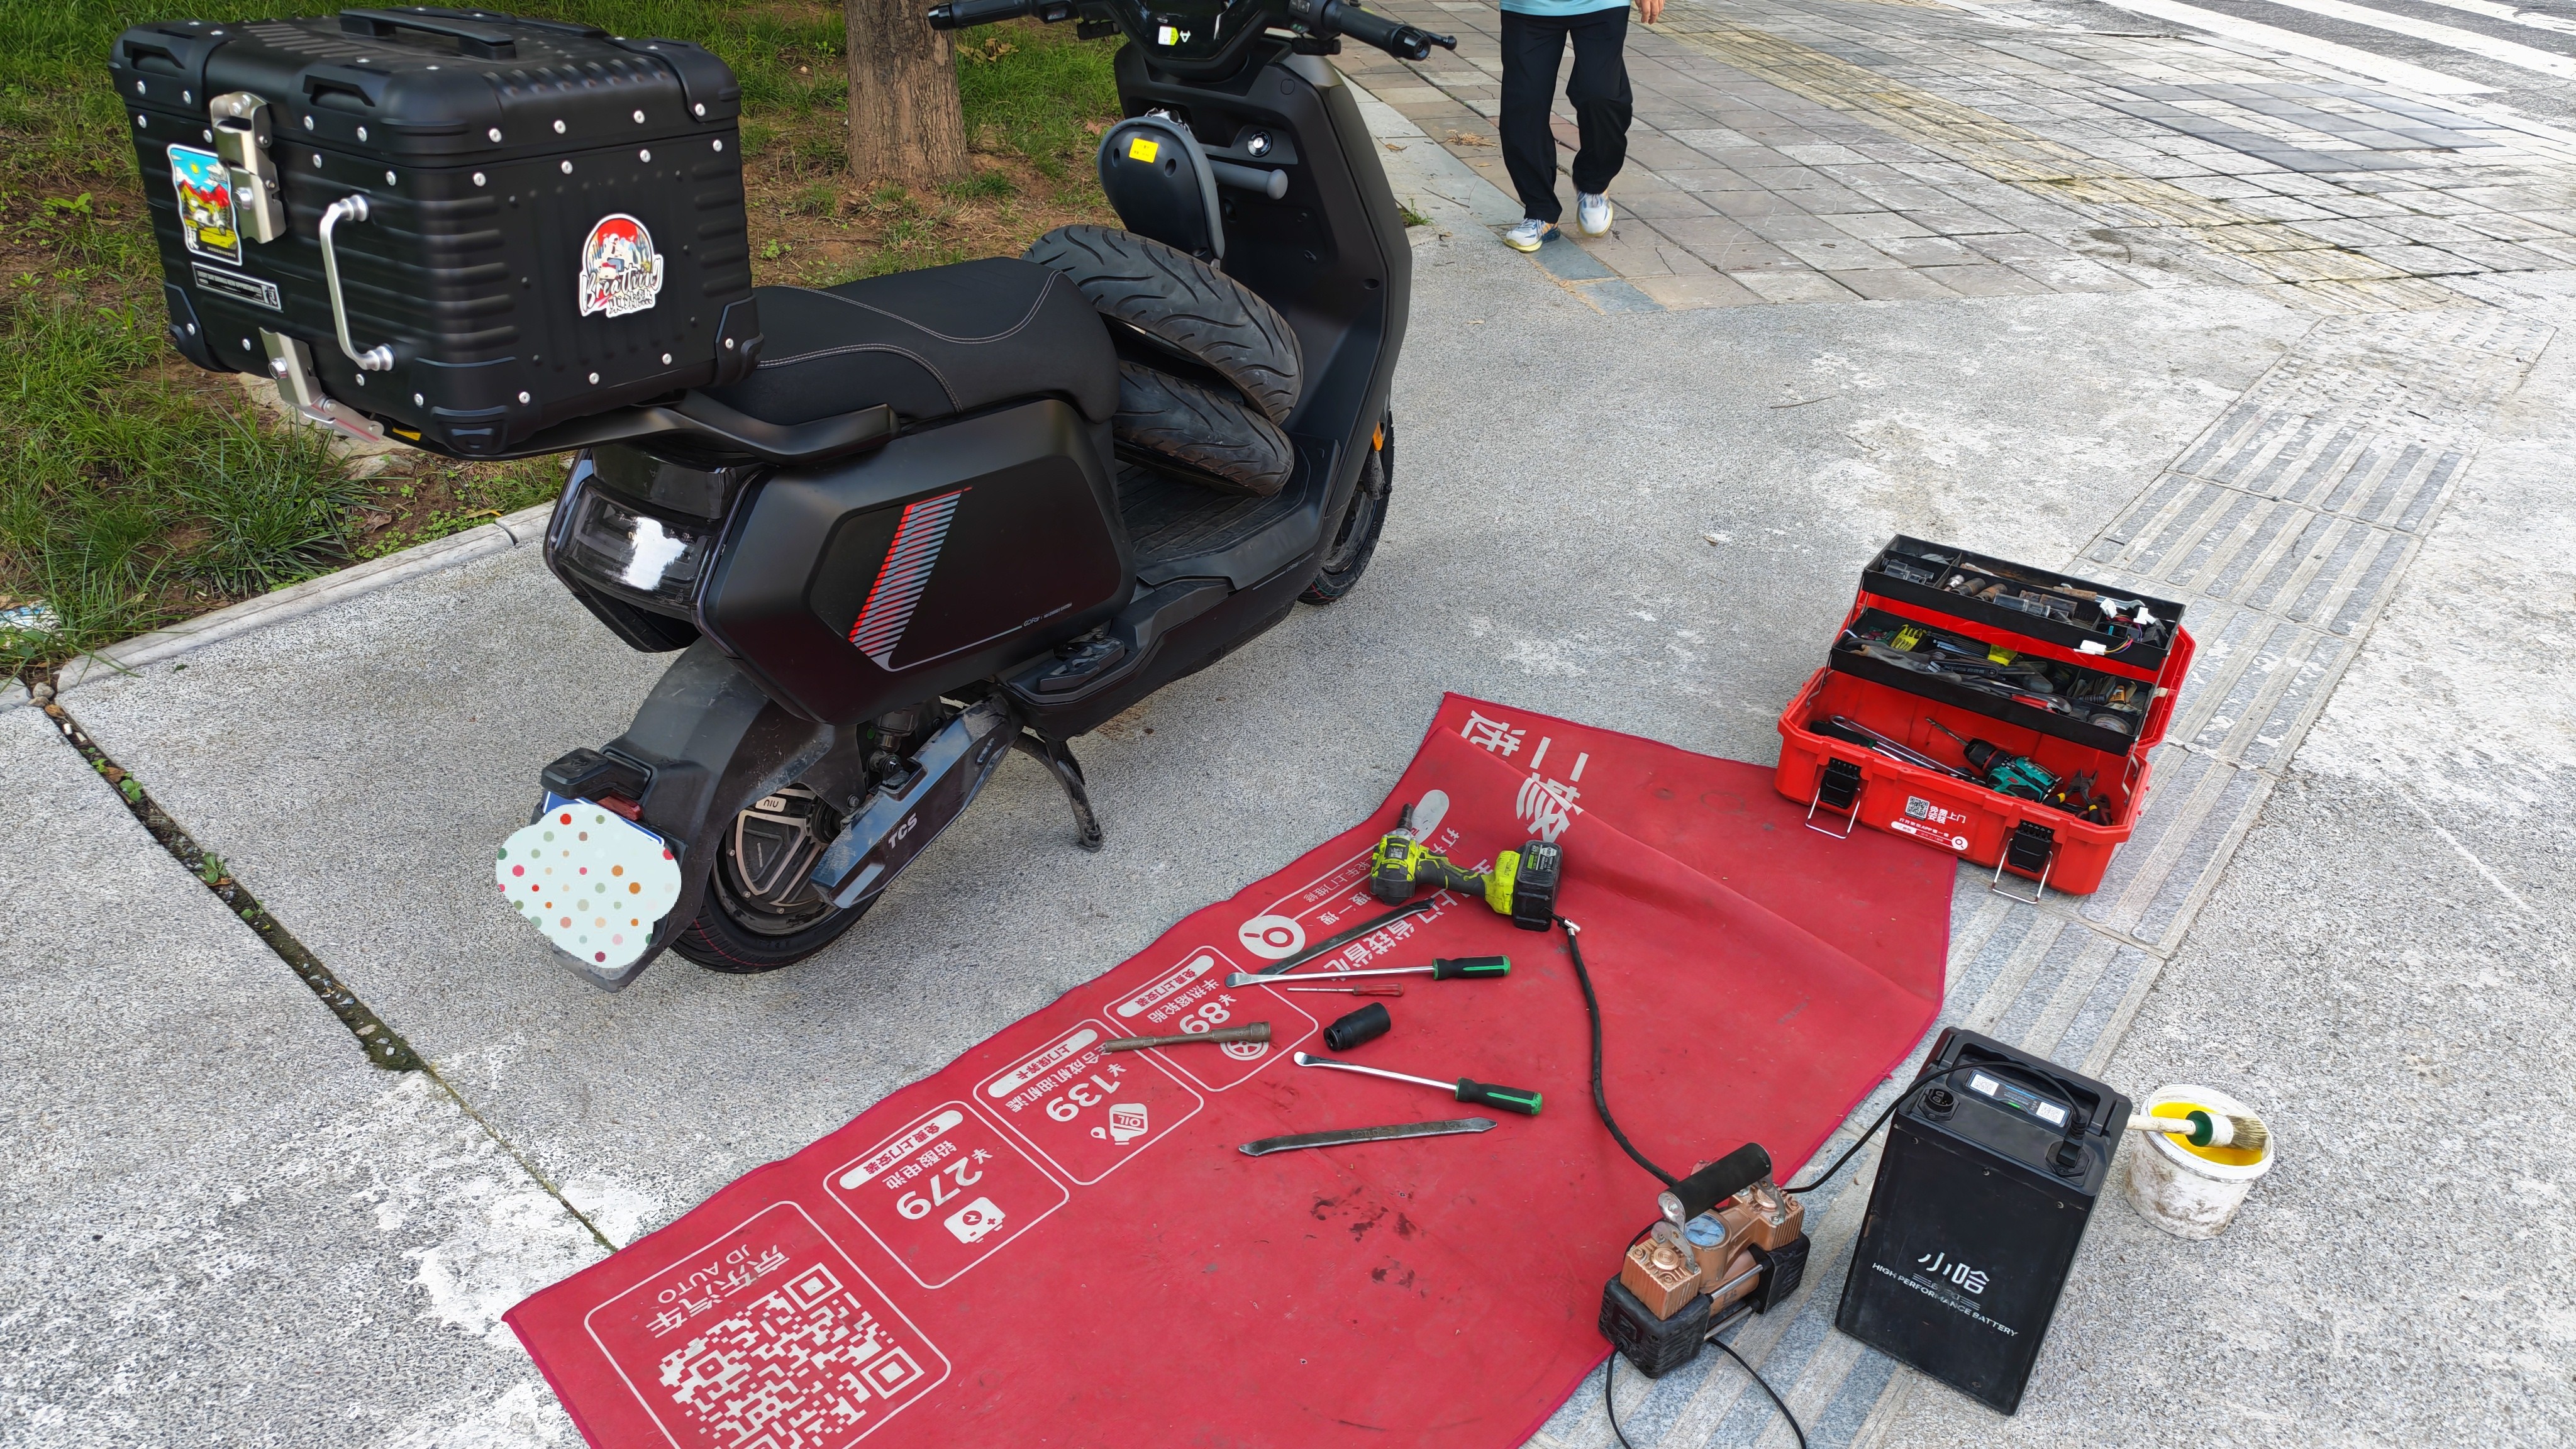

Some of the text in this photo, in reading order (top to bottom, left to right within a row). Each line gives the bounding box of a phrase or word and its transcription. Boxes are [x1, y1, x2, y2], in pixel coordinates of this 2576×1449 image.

[888, 813, 918, 849] TCS
[1135, 969, 1196, 1008] 免费上门安装
[1146, 979, 1219, 1023] 半热熔轮胎
[1179, 994, 1237, 1035] ¥89
[1016, 1044, 1070, 1080] 上门保养卡
[1046, 1063, 1126, 1122] ¥139
[1118, 1115, 1141, 1127] OIL
[863, 1123, 940, 1175] 免费上门安装
[882, 1140, 957, 1190] 铅酸电池
[896, 1148, 993, 1220] ¥279
[645, 1244, 791, 1338] 京东汽车
[658, 1244, 750, 1304] JD AUTO
[1918, 1252, 1990, 1294] 小哈
[1872, 1262, 1897, 1279] HIGH
[1897, 1275, 1972, 1315] PERFORMANCE
[1972, 1311, 2019, 1337] BATTERY
